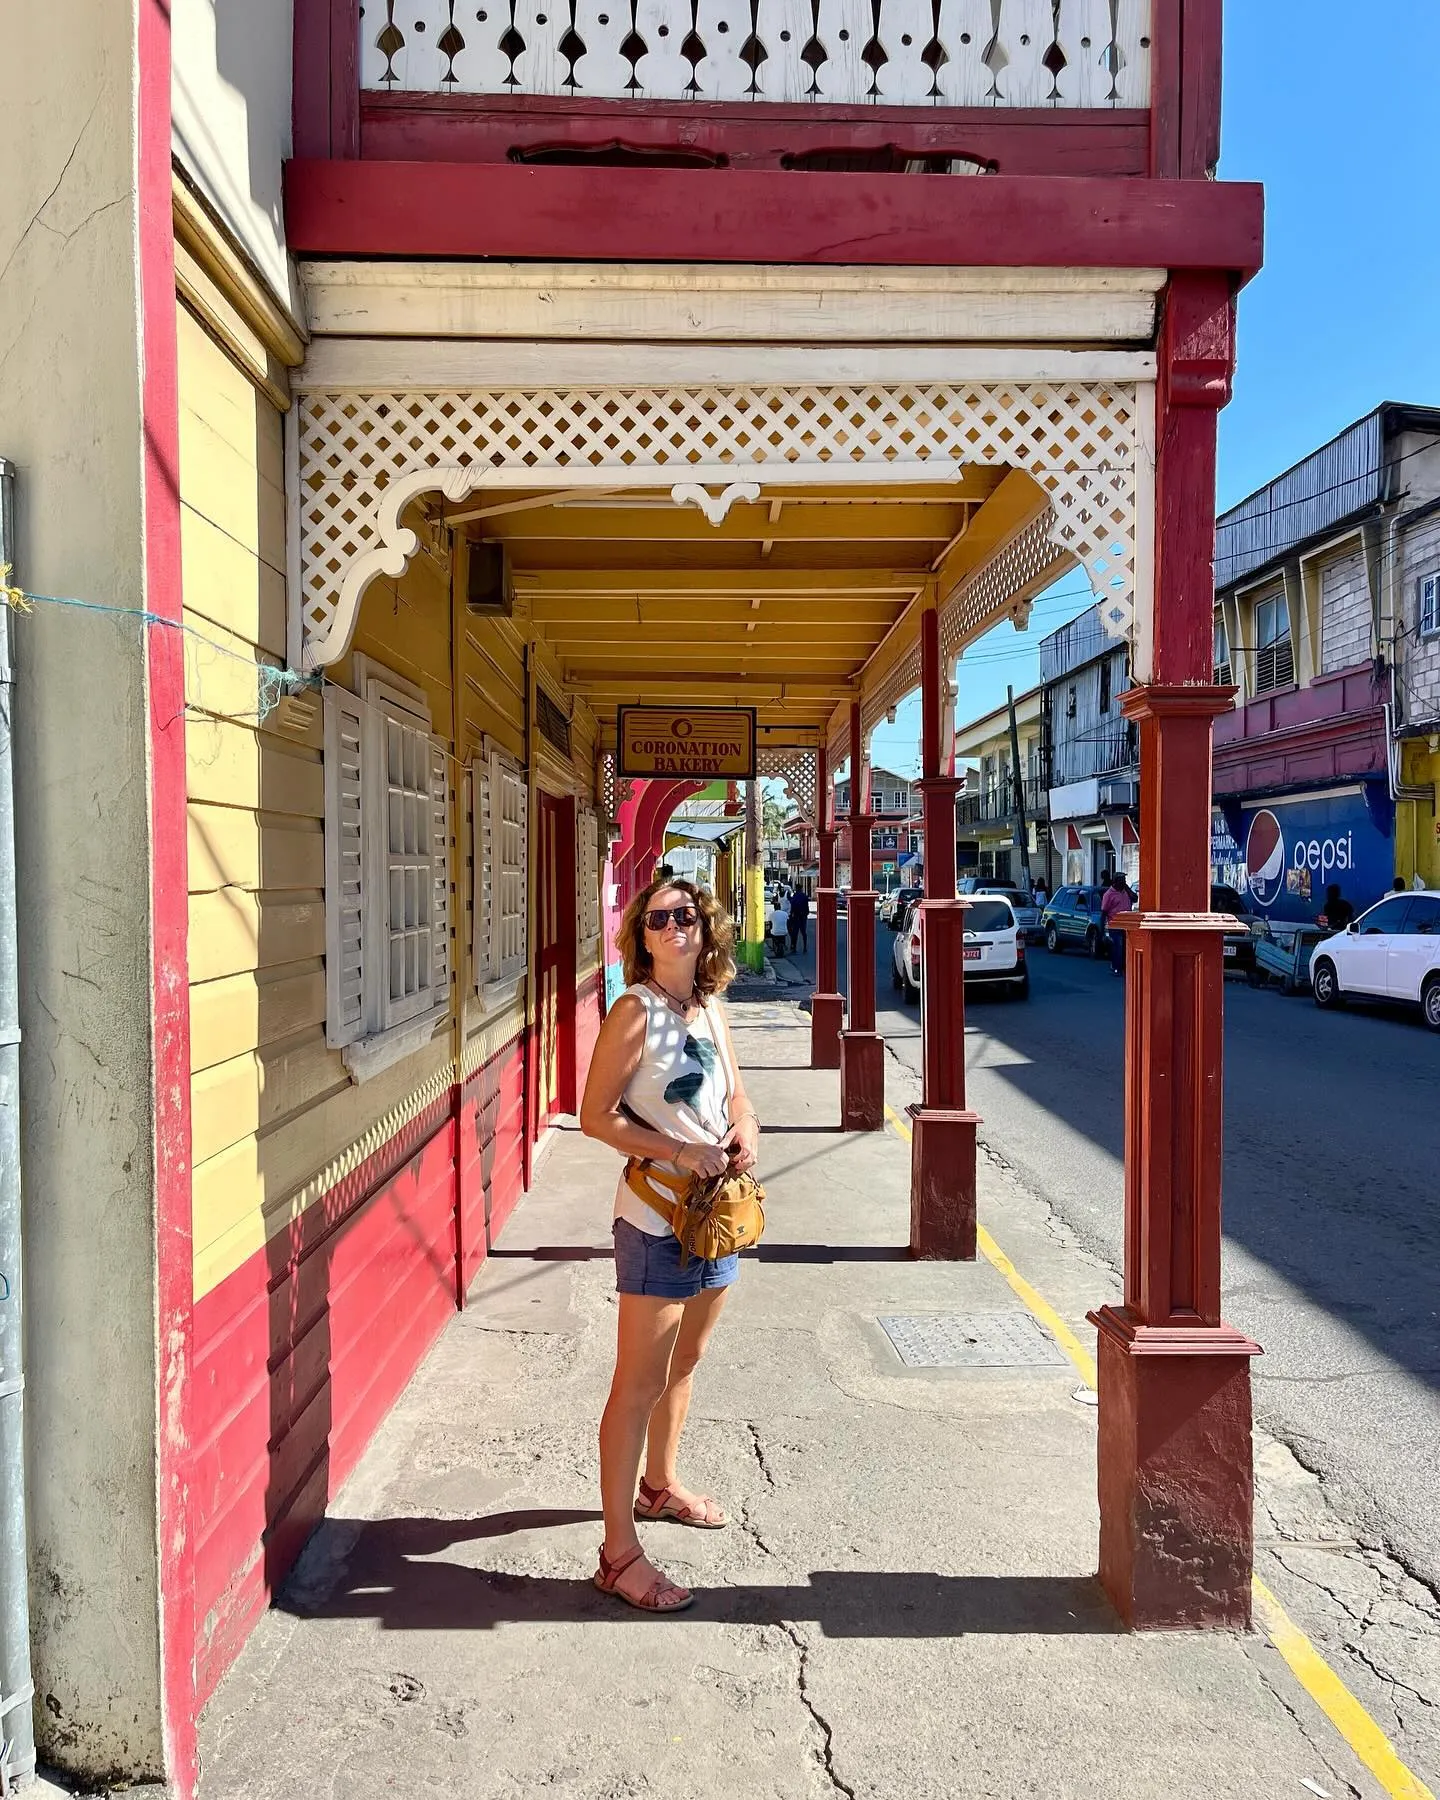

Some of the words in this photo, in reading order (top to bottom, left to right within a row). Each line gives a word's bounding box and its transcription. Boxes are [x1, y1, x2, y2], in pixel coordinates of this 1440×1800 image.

[631, 740, 742, 756] CORONATION
[654, 757, 724, 772] BAKERY
[1294, 830, 1352, 884] pepsi
